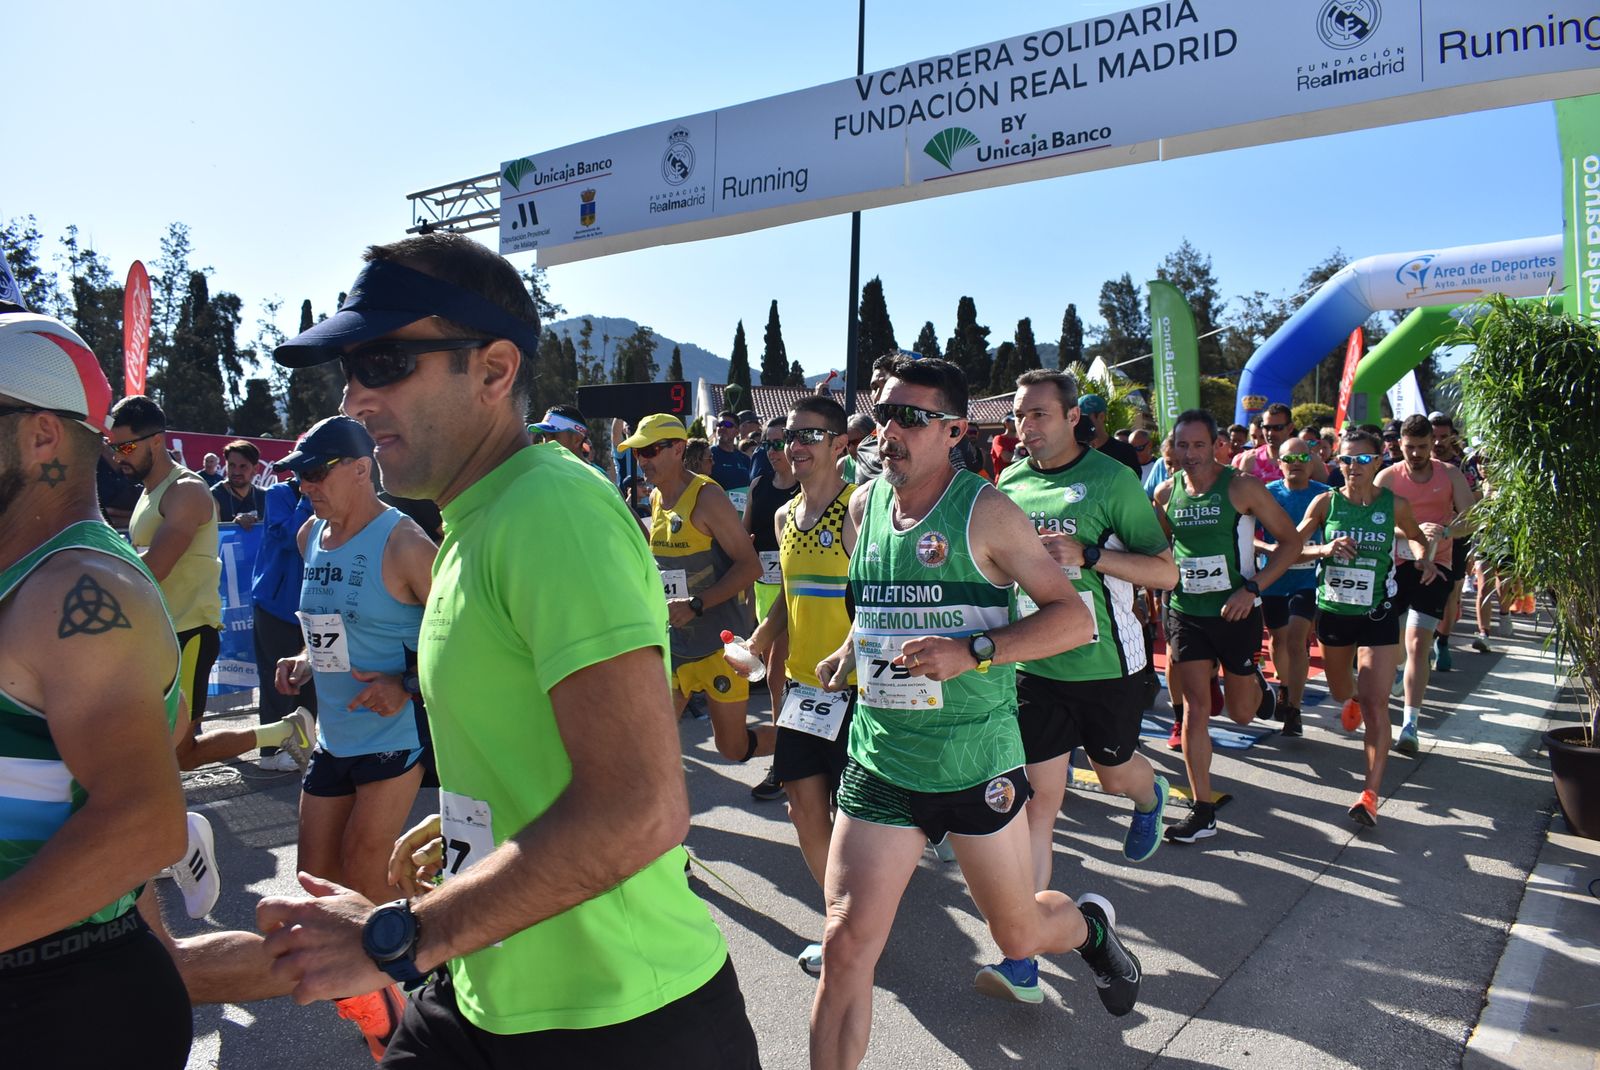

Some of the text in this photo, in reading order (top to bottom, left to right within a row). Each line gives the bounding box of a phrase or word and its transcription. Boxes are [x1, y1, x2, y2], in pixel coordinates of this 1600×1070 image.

[1438, 13, 1600, 64] Running
[856, 0, 1199, 101] V CARRERA SOLIDARIA
[1296, 46, 1405, 74] FUNDACIÓN
[833, 28, 1238, 140] FUNDACIÓN REAL MADRID
[1000, 113, 1027, 134] BY
[976, 125, 1112, 163] Unicaja Banco
[533, 158, 613, 186] Unicaja Banco
[722, 166, 809, 201] Running
[649, 185, 706, 202] FUNDACIÓN
[1433, 255, 1557, 280] Area de Deportes
[1504, 270, 1517, 281] de
[1519, 270, 1529, 281] la
[669, 384, 684, 413] 9
[1174, 504, 1222, 520] mijas
[1175, 518, 1219, 527] ATLETISMO
[1330, 526, 1387, 545] mijas
[1186, 567, 1223, 580] 294
[1329, 577, 1369, 591] 295
[861, 584, 943, 603] ATLETISMO
[799, 698, 833, 716] 66
[40, 913, 139, 961] COMBAT
